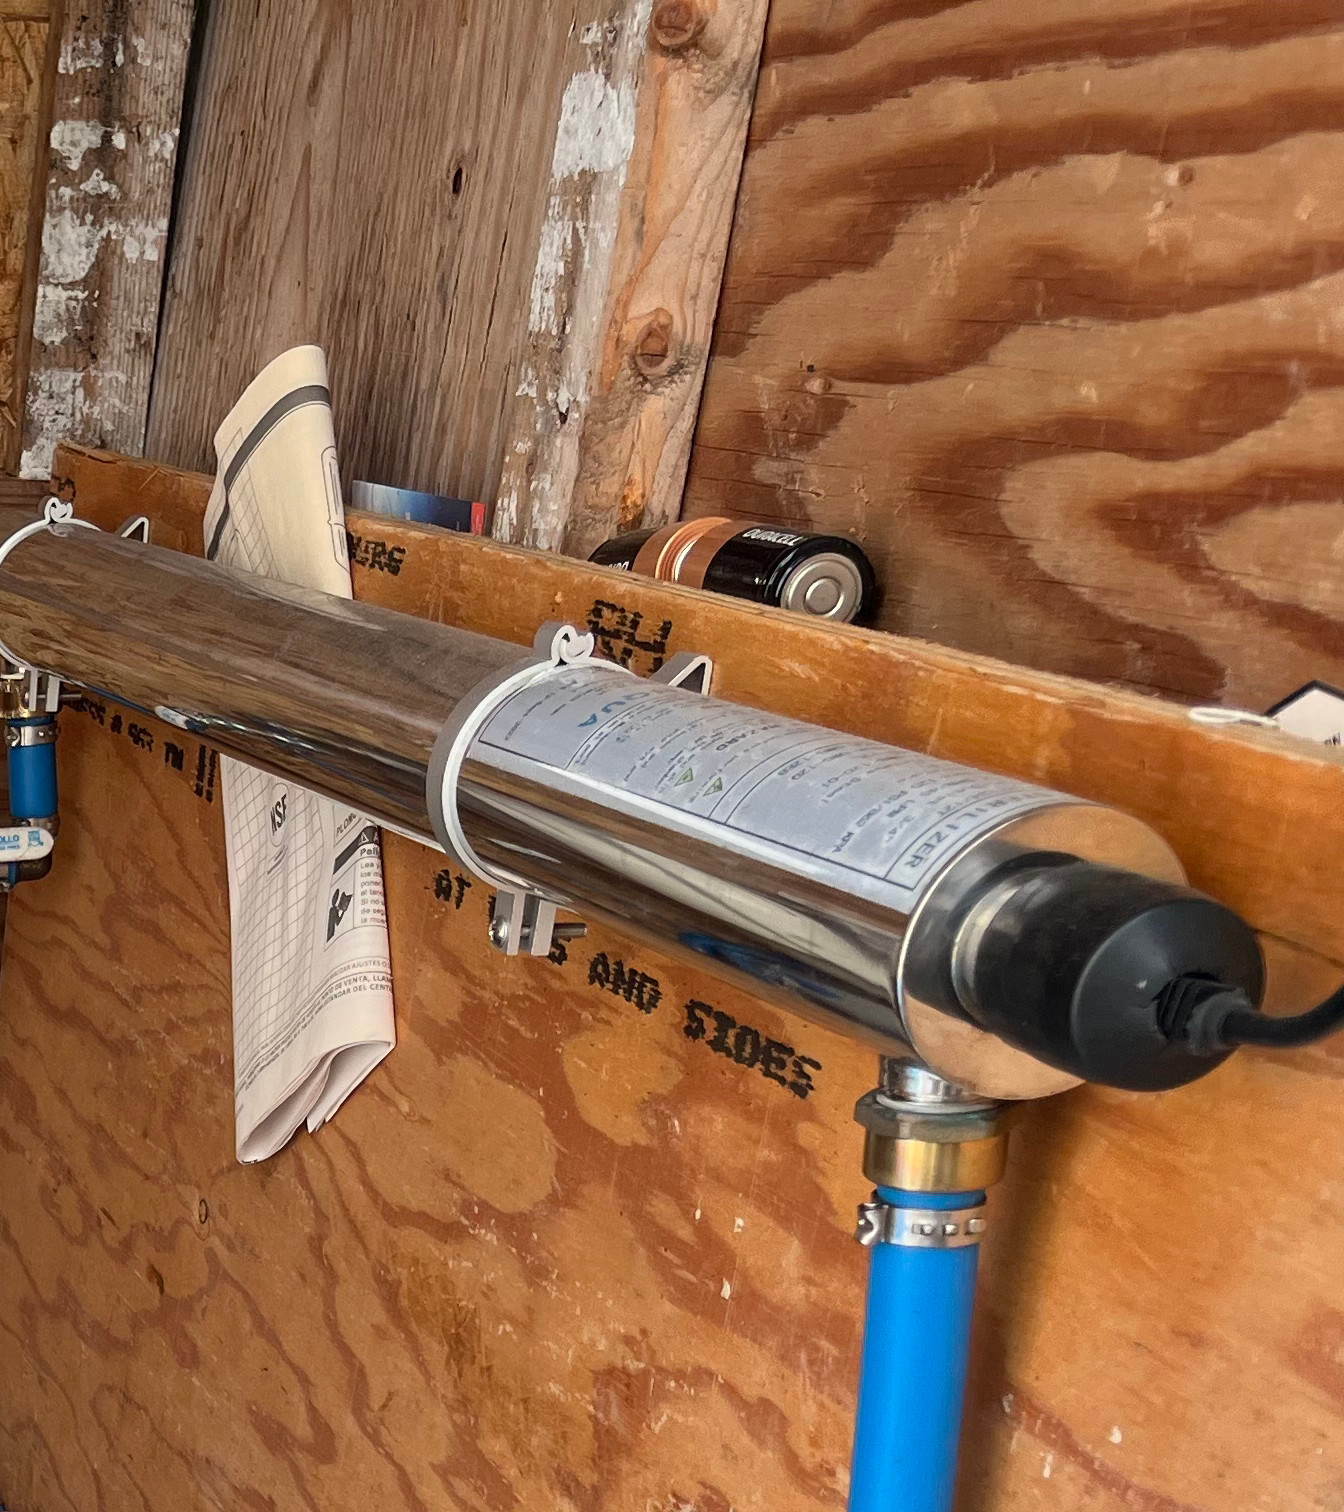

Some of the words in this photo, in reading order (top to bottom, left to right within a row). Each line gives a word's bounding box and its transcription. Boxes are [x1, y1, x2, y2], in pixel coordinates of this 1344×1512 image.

[742, 528, 804, 547] DURACELL
[270, 793, 287, 836] NSF
[360, 846, 380, 858] Peli
[683, 999, 823, 1099] SIDES
